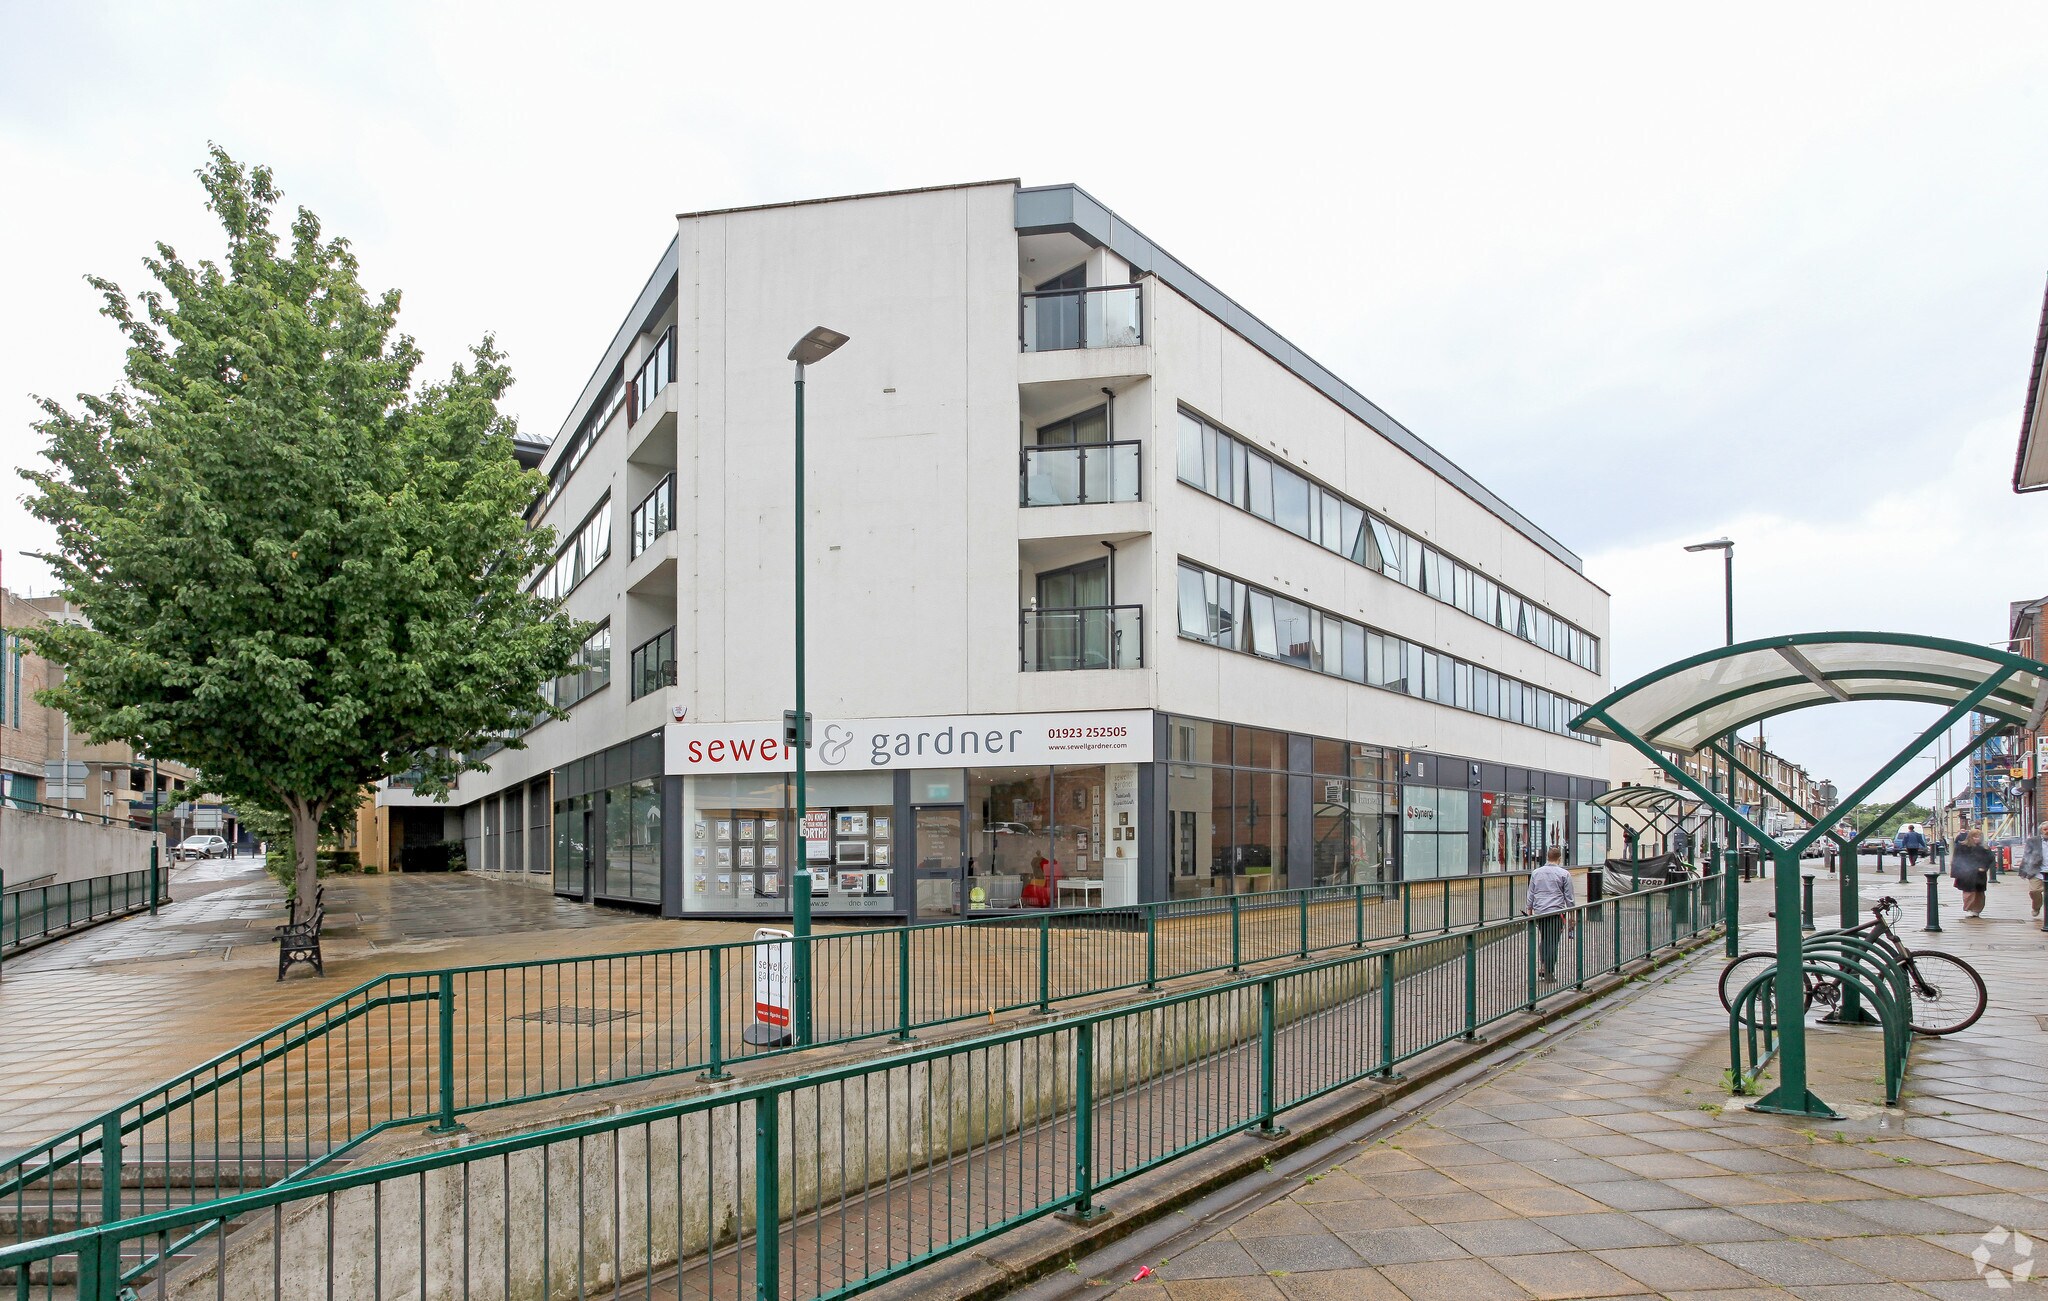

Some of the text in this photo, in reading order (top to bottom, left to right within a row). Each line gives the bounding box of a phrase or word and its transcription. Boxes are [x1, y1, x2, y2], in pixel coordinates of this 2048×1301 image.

[1048, 726, 1127, 739] 01923 252505
[688, 724, 1023, 766] sewe & gardner
[1048, 743, 1128, 751] www.sewellgardner.com
[814, 813, 828, 821] KNOW
[1414, 807, 1434, 820] Synergi
[805, 827, 828, 839] ORTH?
[757, 971, 788, 984] gadner
